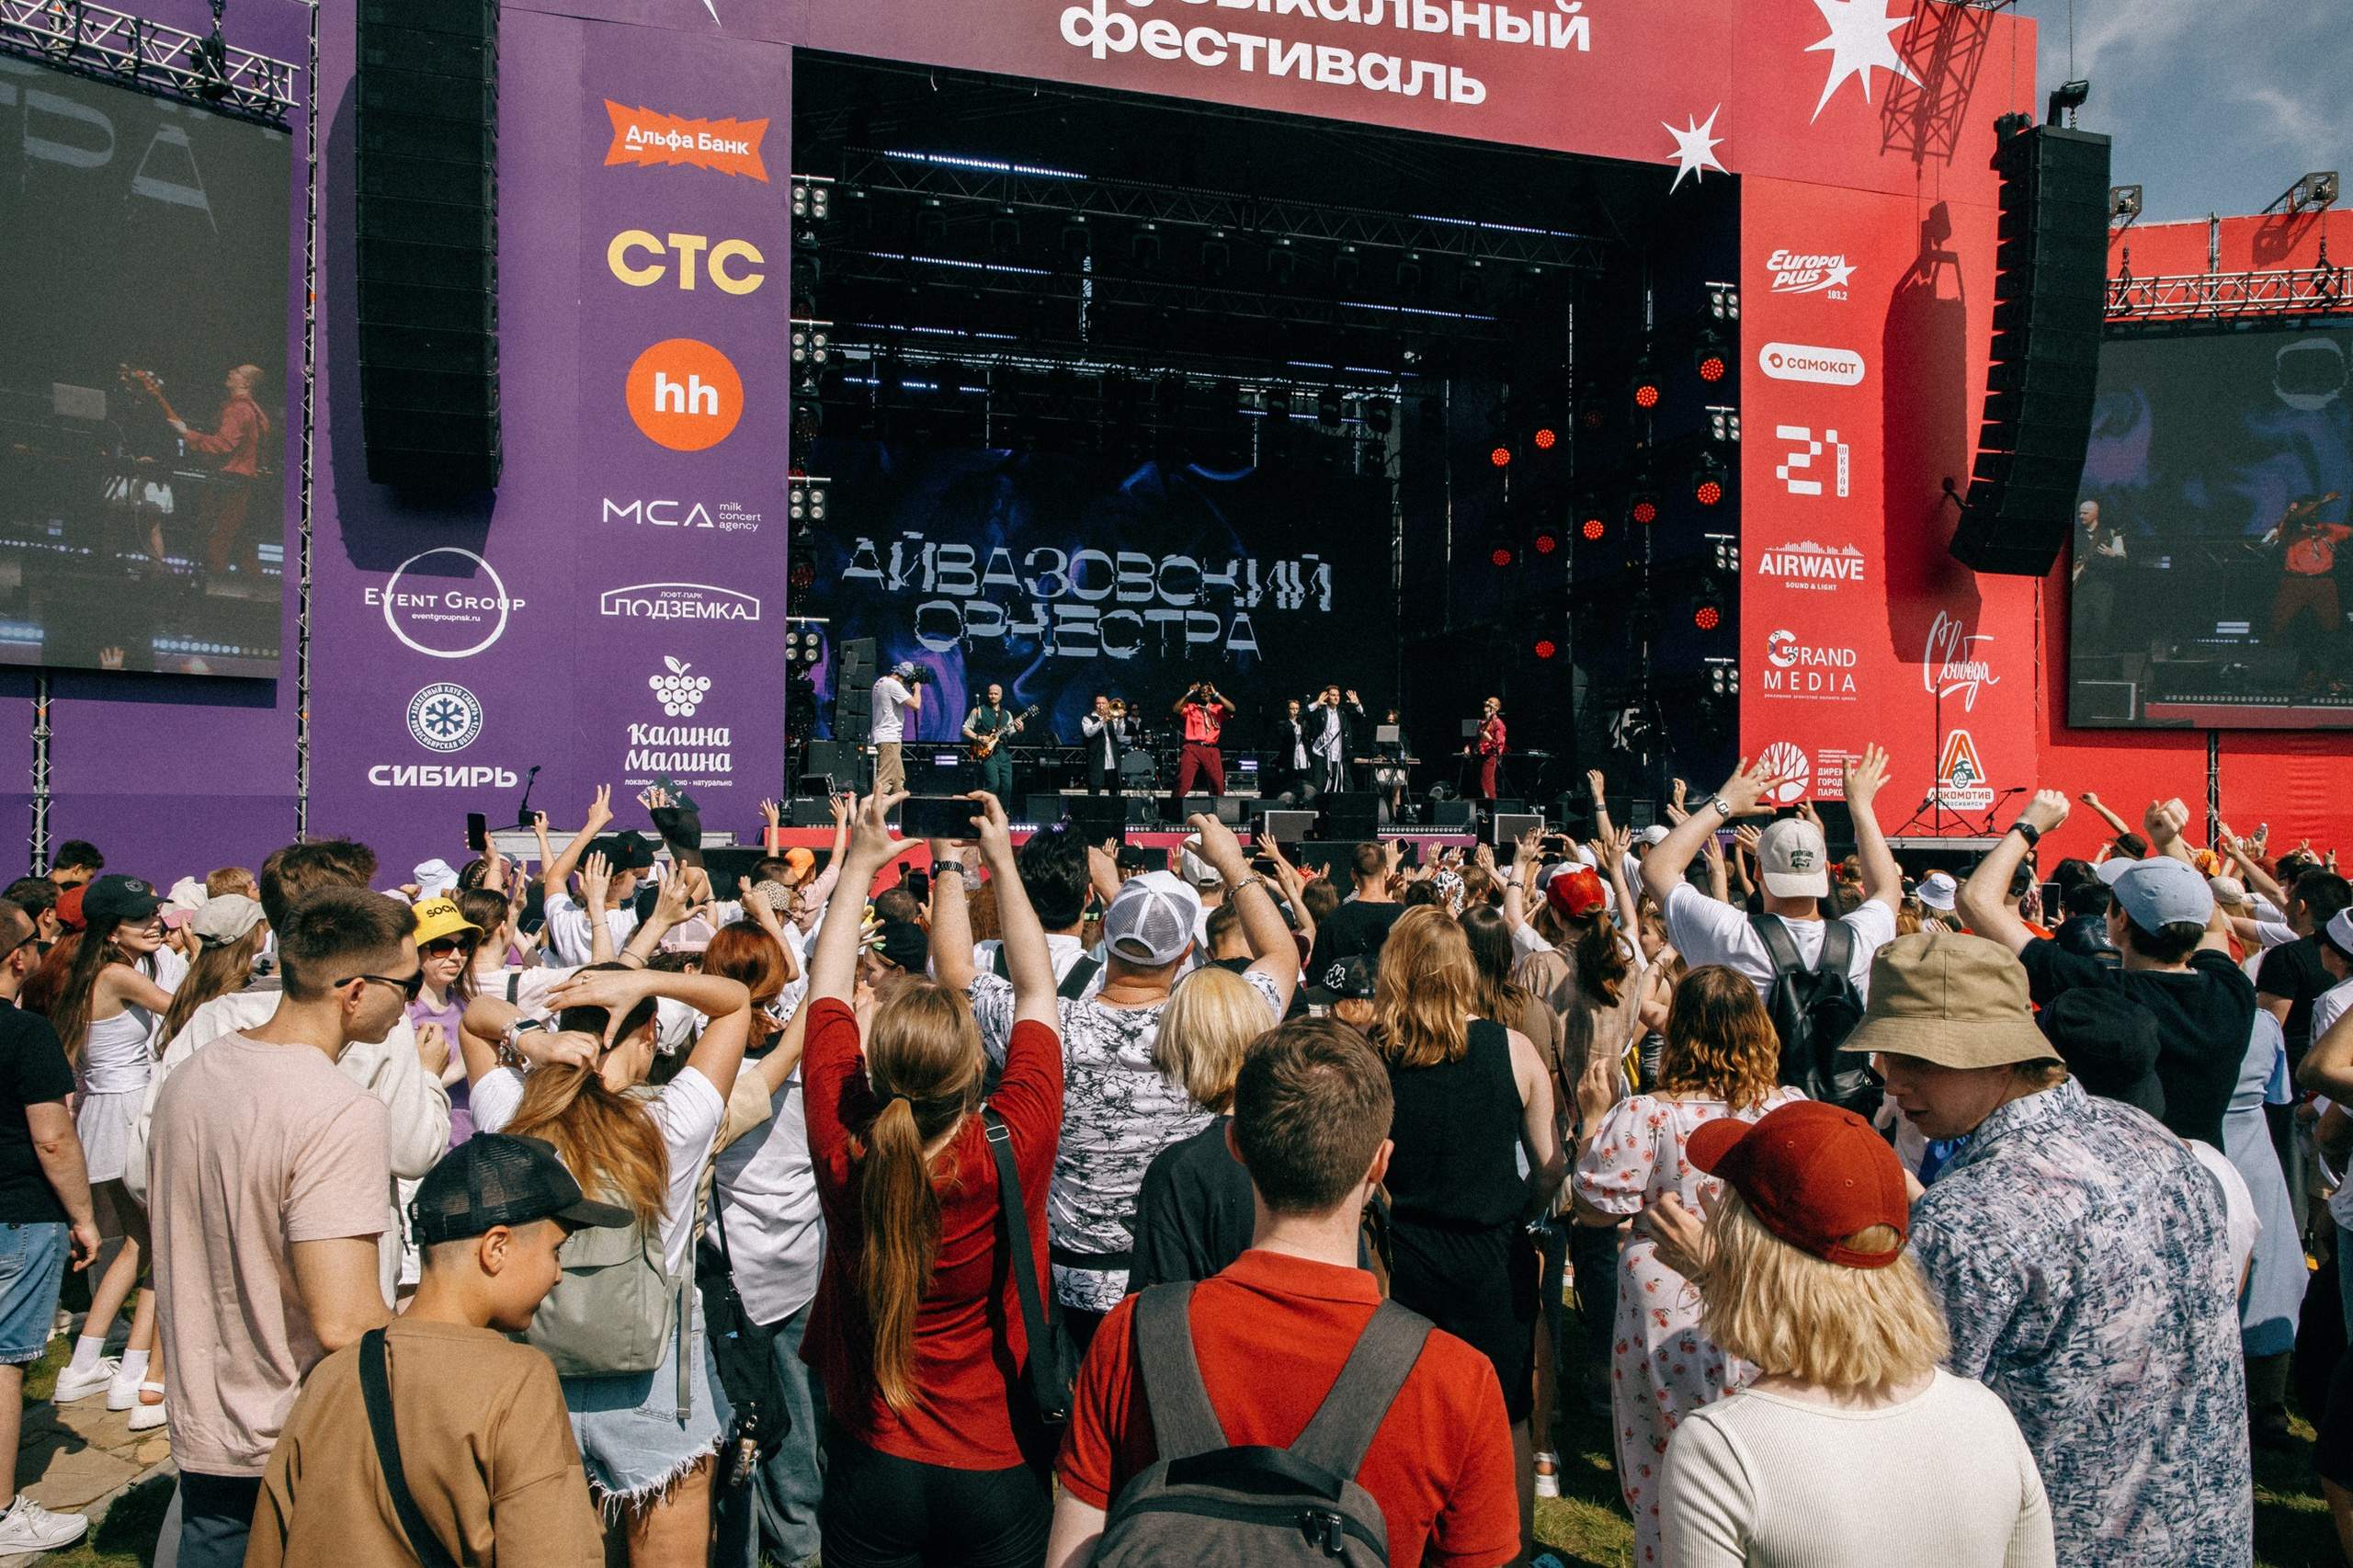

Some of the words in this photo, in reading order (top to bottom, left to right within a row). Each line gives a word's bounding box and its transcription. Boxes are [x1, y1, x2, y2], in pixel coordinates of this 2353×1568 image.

[1060, 0, 1487, 106] фестиваль
[625, 125, 694, 152] Альфа
[698, 133, 750, 155] Банк
[607, 230, 765, 295] СТС
[1827, 290, 1847, 301] 103.2
[1787, 358, 1857, 374] самокат
[655, 372, 719, 415] hh
[1776, 425, 1849, 497] 21
[603, 498, 715, 528] MCA
[719, 502, 743, 512] milk
[719, 512, 762, 522] concert
[719, 521, 759, 532] agency
[1758, 553, 1865, 581] AIRWAVE
[660, 591, 704, 600] ЛОФТ-ПАРК
[1785, 582, 1809, 590] SOUND
[412, 612, 481, 622] eventgroupnsk.ru
[614, 597, 747, 620] ПОДЗЕМКА
[1766, 629, 1857, 668] GRAND
[1764, 670, 1857, 693] MEDIA
[411, 685, 443, 715] ХОККЕЙНЫЙ
[444, 686, 463, 696] КЛУБ
[461, 693, 479, 716] СИБИРЬ
[410, 720, 459, 750] НОВОСИБИРСКАЯ
[458, 721, 479, 745] ОБЛАСТЬ
[627, 722, 733, 747] Калина
[625, 749, 733, 772] Малина
[369, 765, 518, 788] СИБИРЬ
